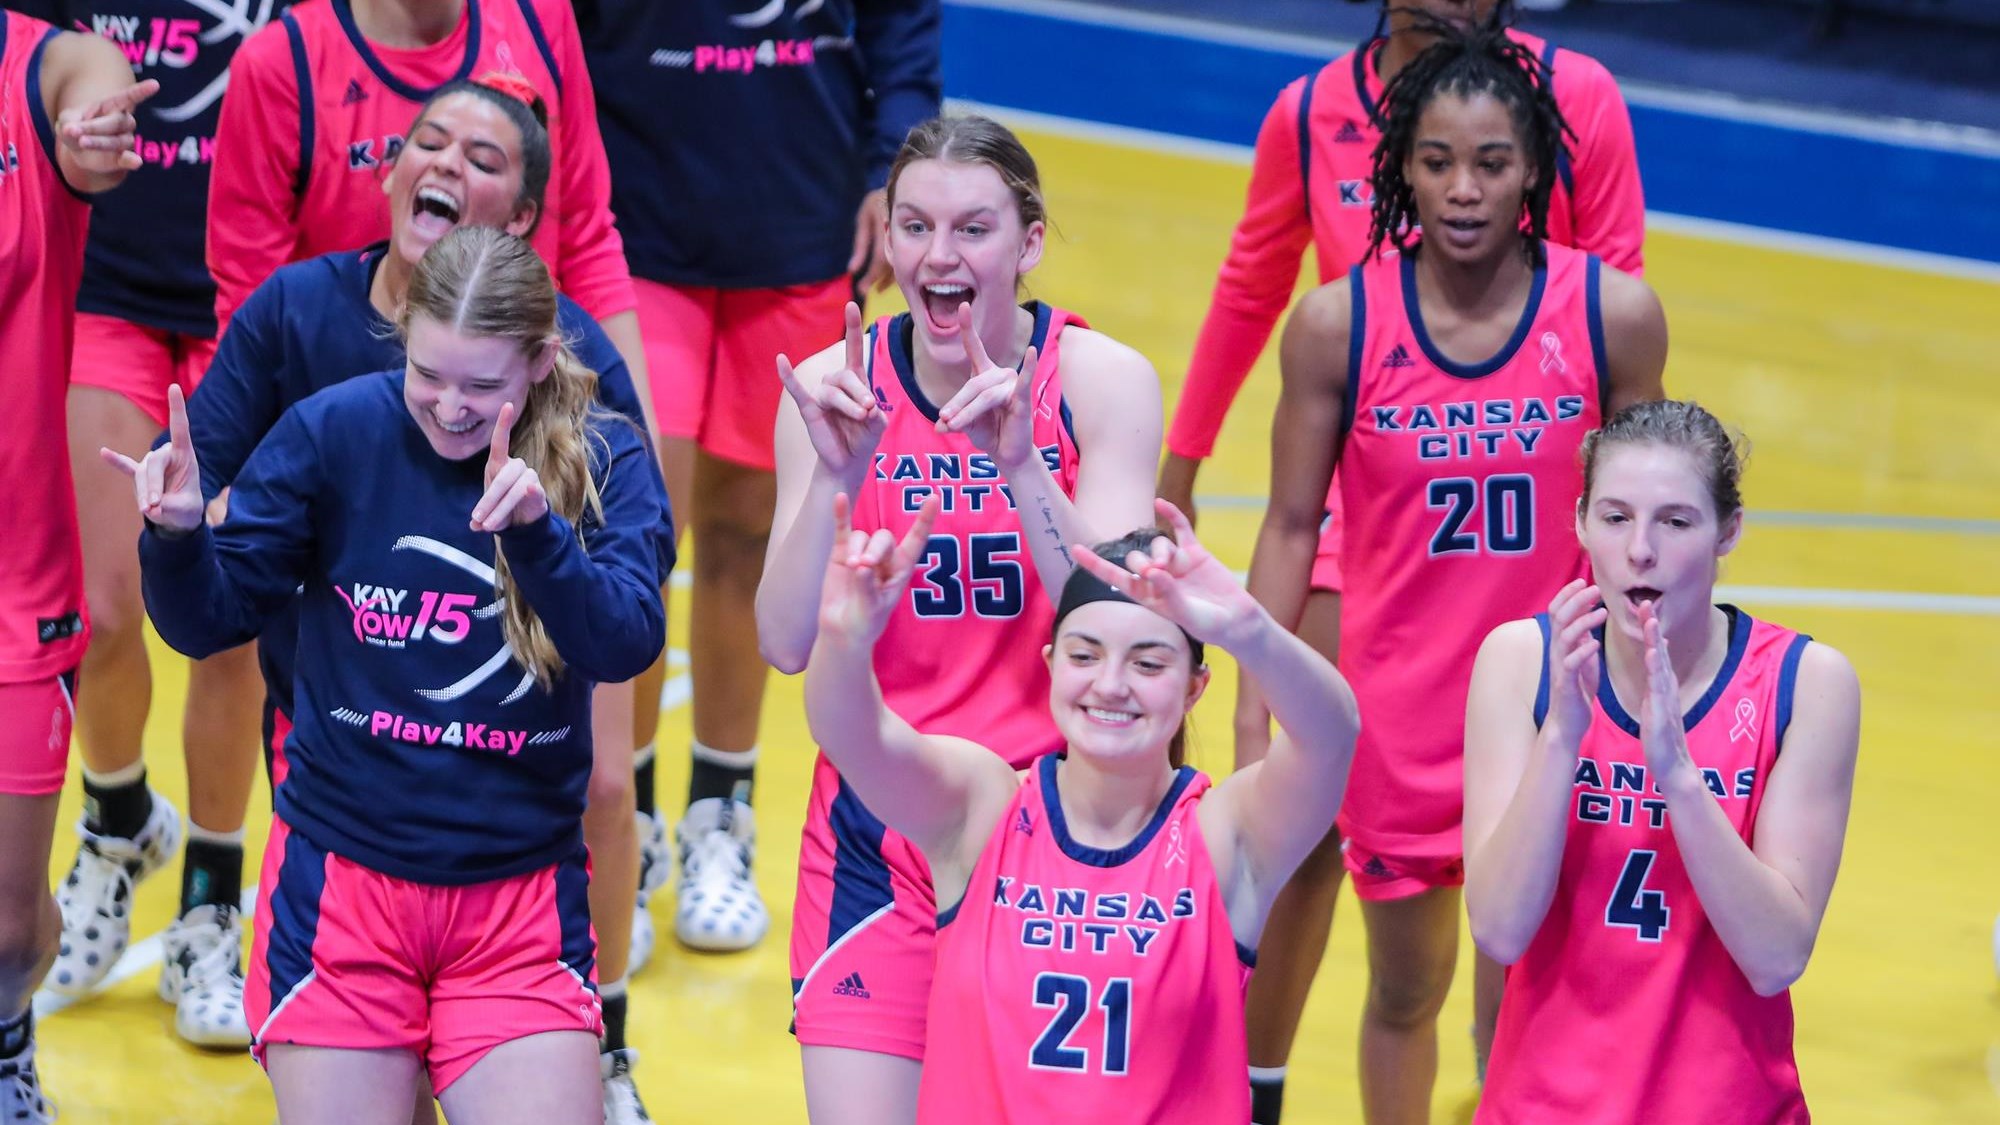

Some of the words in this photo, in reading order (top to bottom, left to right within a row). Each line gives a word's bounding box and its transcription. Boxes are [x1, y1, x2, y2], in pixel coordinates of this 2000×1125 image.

[145, 18, 202, 68] 15
[695, 38, 815, 75] Play4Ka
[134, 134, 217, 169] lay4K
[1371, 396, 1584, 431] KANSAS
[876, 444, 1062, 480] ANSS
[1418, 428, 1544, 460] CITY
[1428, 473, 1535, 557] 20
[911, 532, 1024, 618] 35
[354, 583, 408, 613] KAY
[410, 591, 477, 644] 15
[387, 638, 406, 649] fund
[371, 711, 528, 756] Play4Kay
[1573, 757, 1757, 798] ANAS
[1578, 792, 1669, 829] CIT
[993, 875, 1195, 924] KANSAS
[1604, 848, 1670, 942] 4
[1022, 918, 1160, 956] CITY
[833, 986, 871, 1000] adidas
[1028, 971, 1132, 1076] 21
